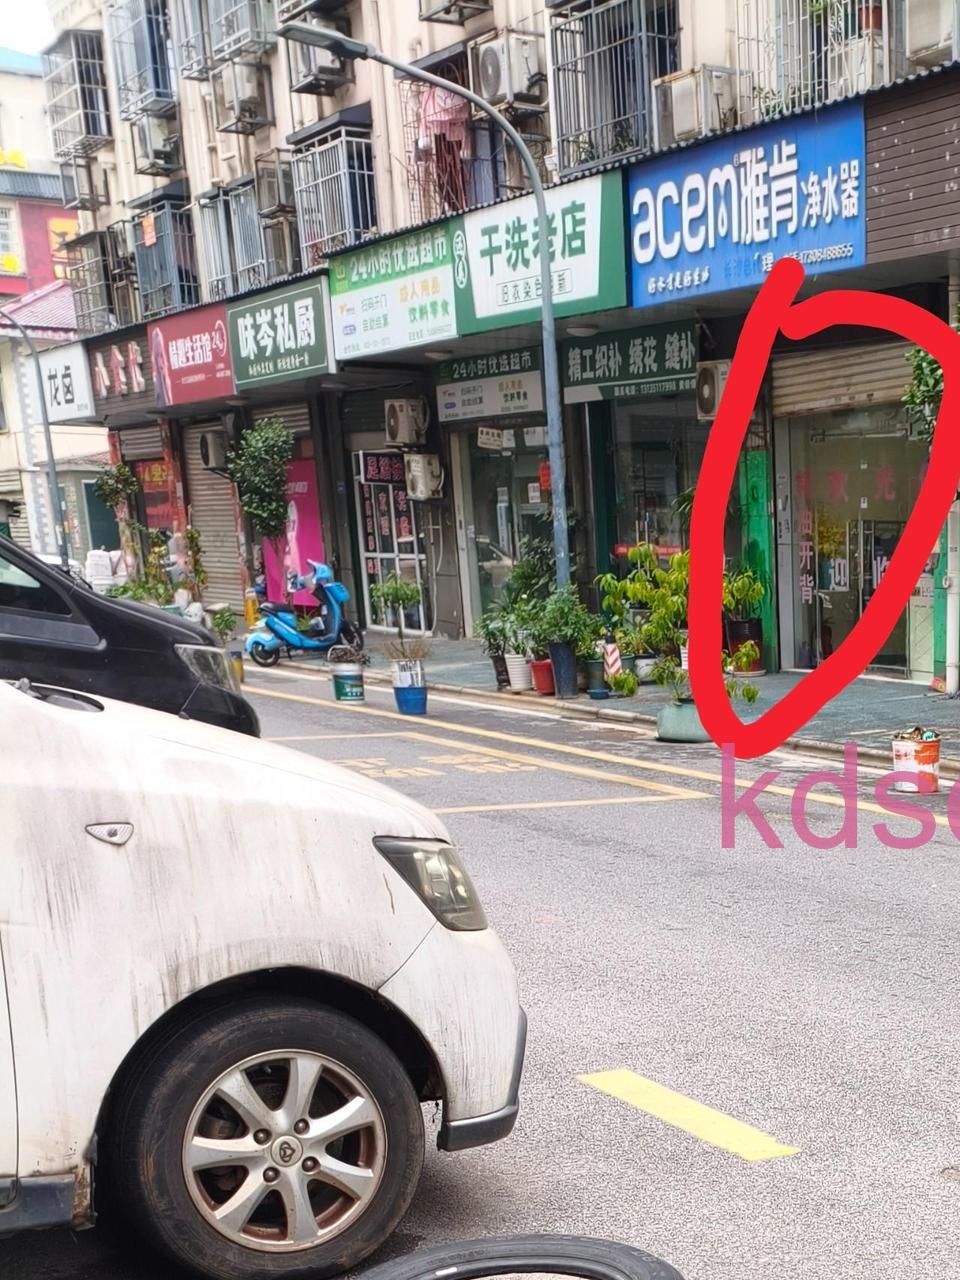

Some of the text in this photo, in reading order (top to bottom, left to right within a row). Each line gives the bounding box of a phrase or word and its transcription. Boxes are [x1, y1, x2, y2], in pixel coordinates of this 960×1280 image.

[739, 138, 799, 244] 雅肯
[801, 159, 861, 230] 净水器
[568, 330, 696, 382] 精工织补 绣花 缝补
